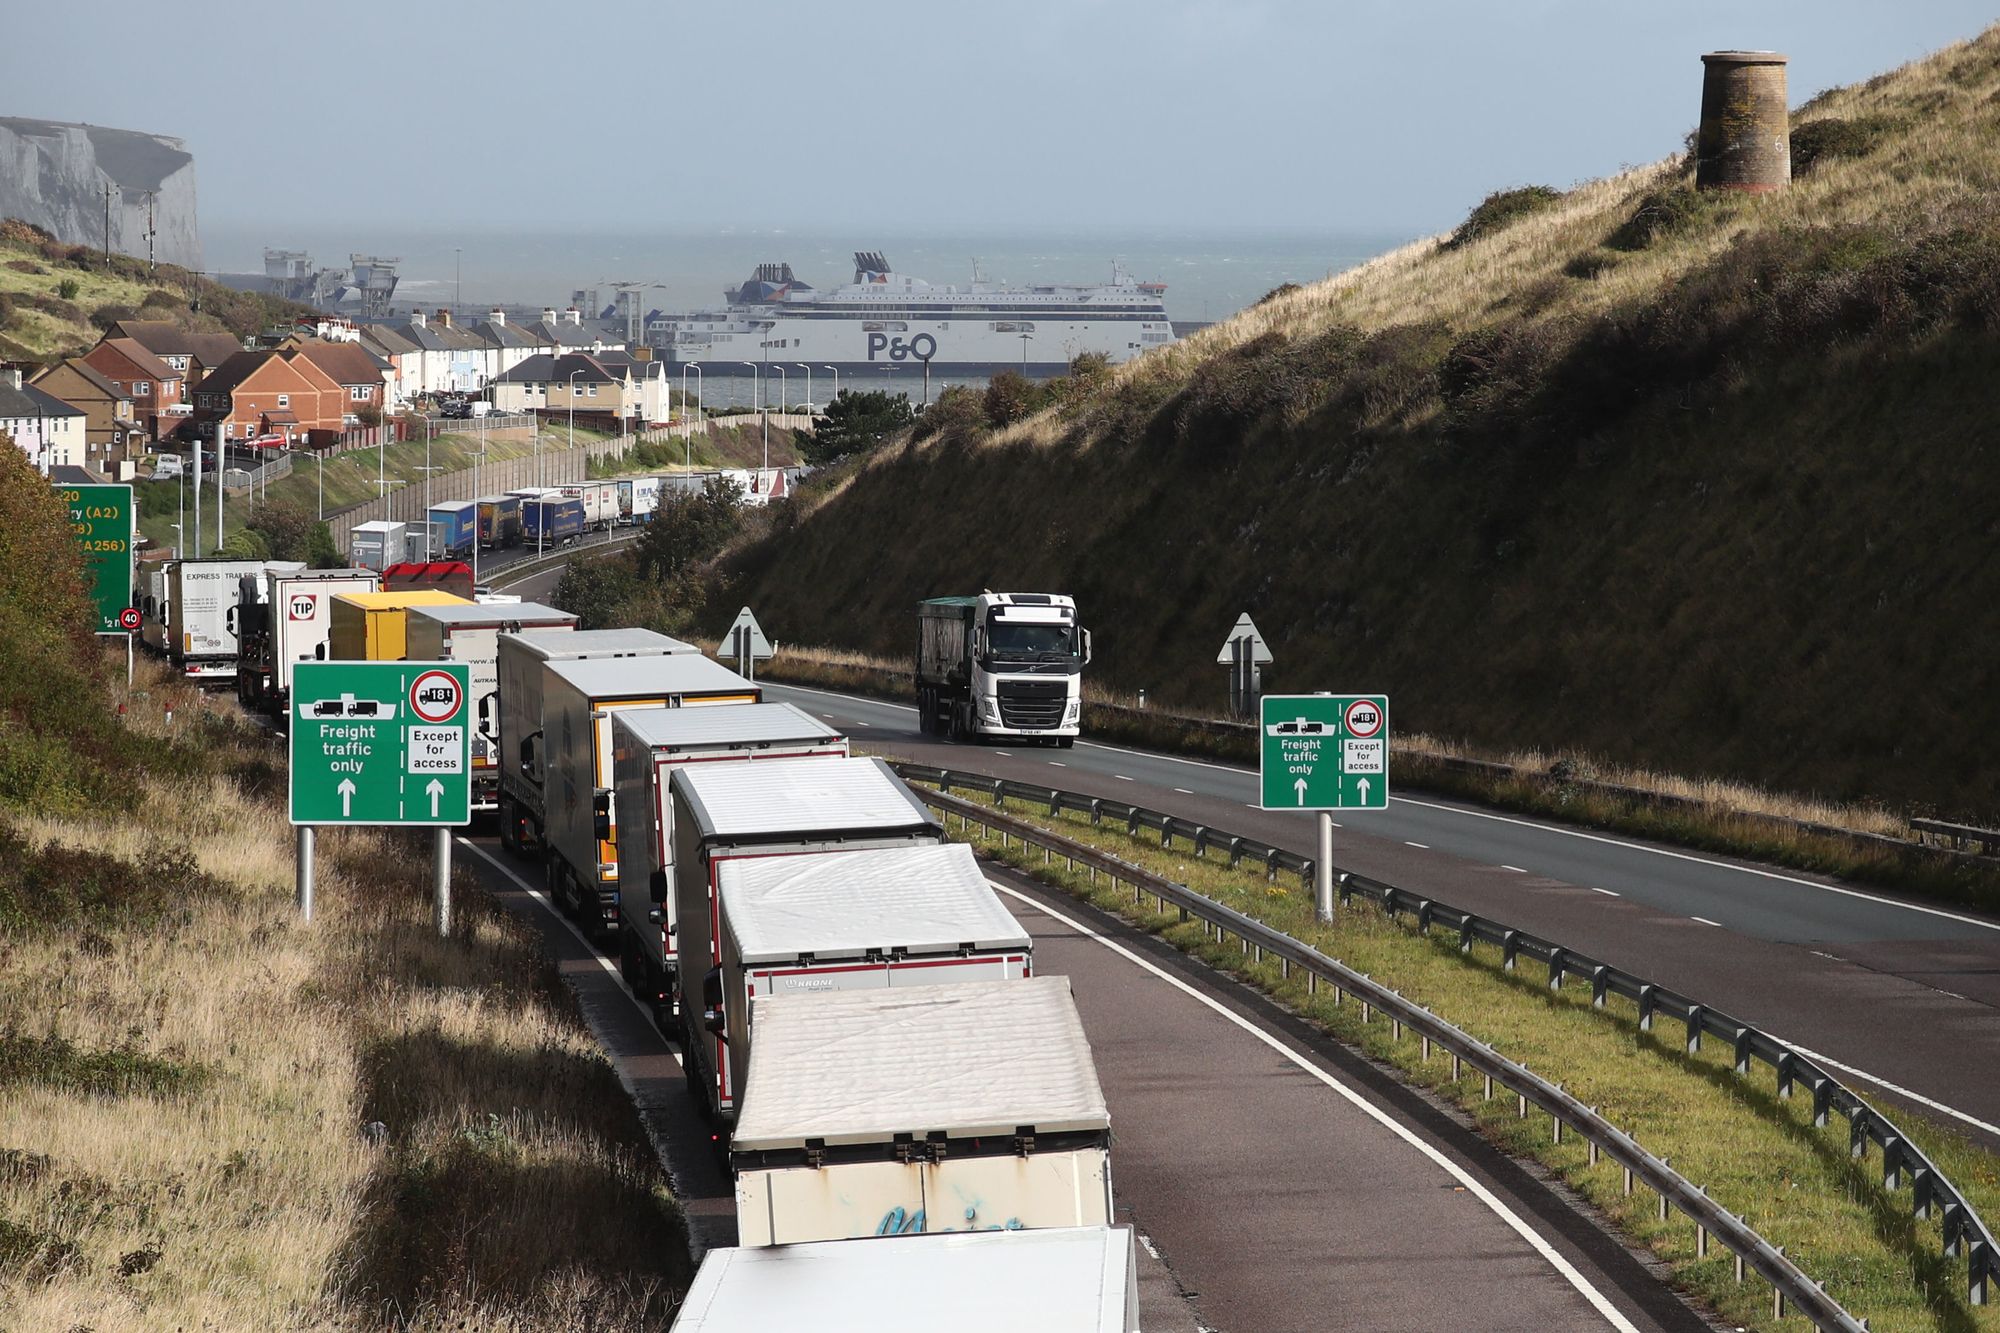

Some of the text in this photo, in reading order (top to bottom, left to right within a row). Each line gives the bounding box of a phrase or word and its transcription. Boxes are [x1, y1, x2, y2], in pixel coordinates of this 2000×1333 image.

[868, 332, 937, 361] P&O
[62, 490, 80, 502] 20
[186, 573, 221, 581] EXPRESS
[292, 603, 313, 615] TIP
[124, 613, 137, 624] 40
[431, 689, 445, 700] 18
[320, 724, 376, 741] Freight
[414, 730, 459, 743] Except
[322, 741, 372, 756] traffic
[425, 744, 445, 755] for
[1281, 739, 1322, 752] Freight
[1348, 742, 1380, 753] Except
[1283, 751, 1319, 762] traffic
[1357, 752, 1371, 760] for
[330, 758, 364, 775] only
[413, 758, 457, 768] access
[1288, 764, 1313, 776] only
[798, 979, 834, 987] KRONE
